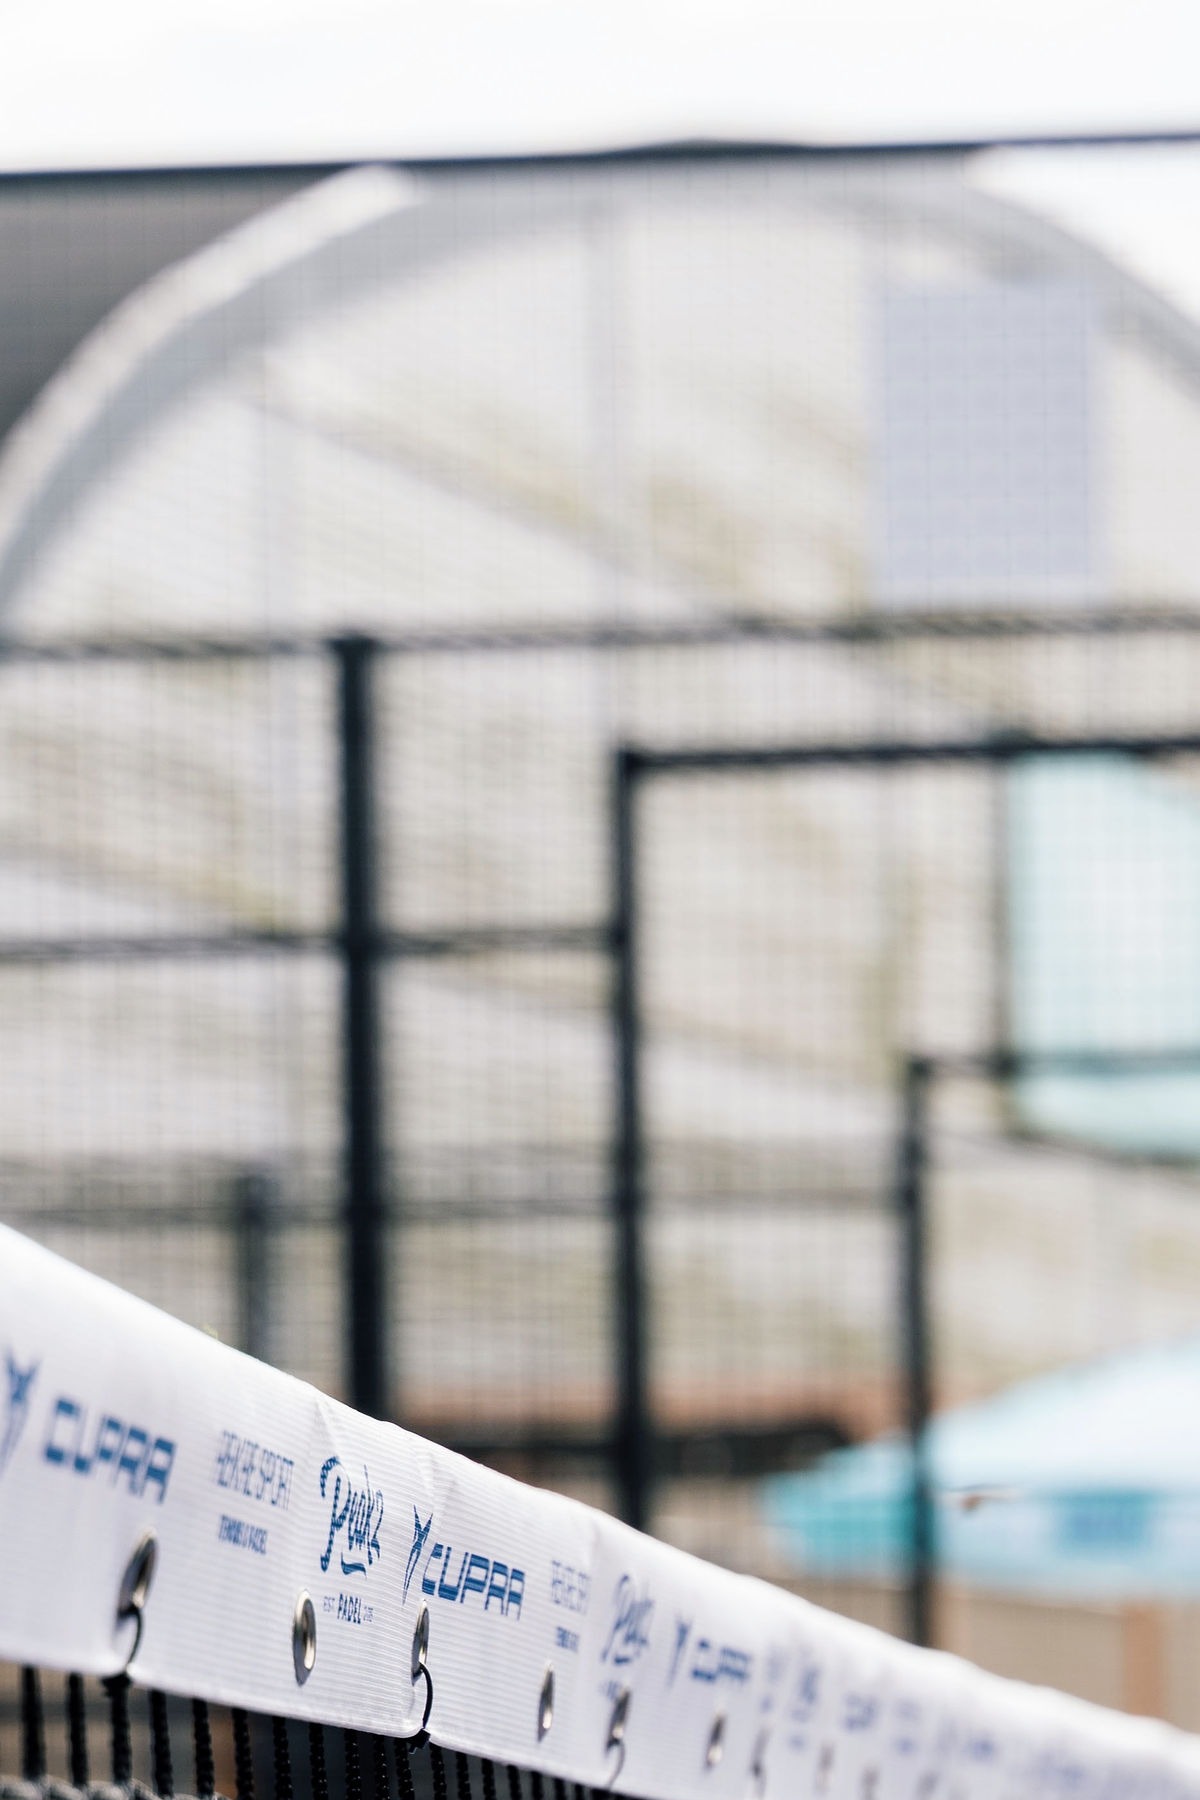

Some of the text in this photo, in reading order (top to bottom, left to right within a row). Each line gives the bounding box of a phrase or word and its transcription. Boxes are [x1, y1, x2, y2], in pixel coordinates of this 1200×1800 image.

[43, 1397, 176, 1505] CUPRA
[337, 1593, 361, 1624] PADEL
[421, 1543, 525, 1620] CUPRA
